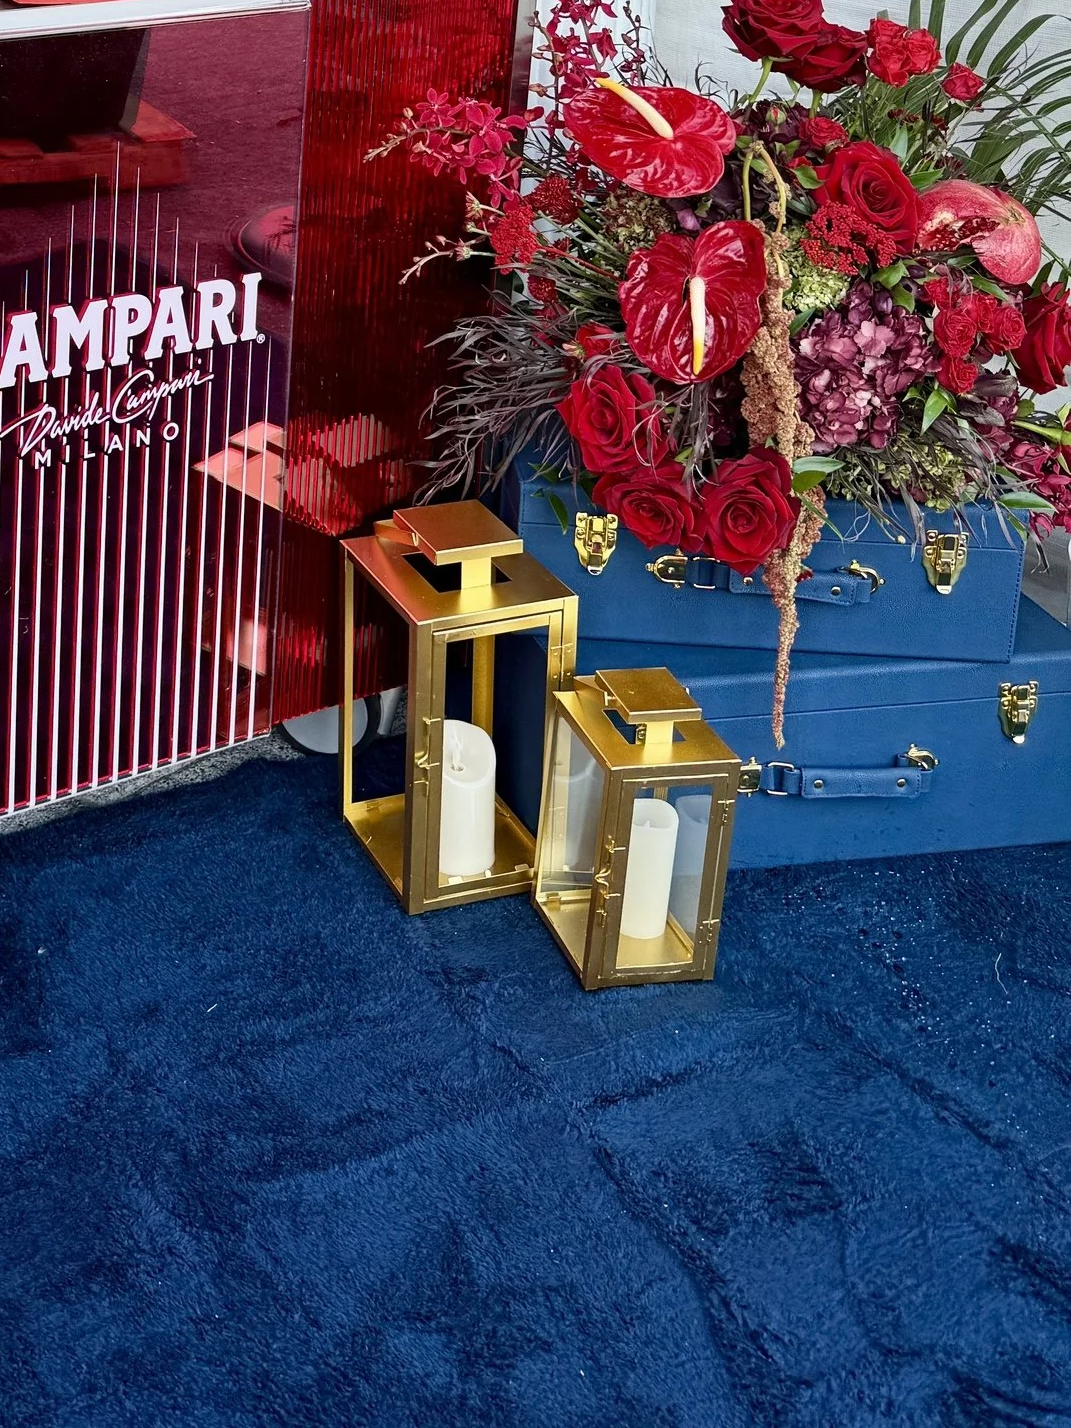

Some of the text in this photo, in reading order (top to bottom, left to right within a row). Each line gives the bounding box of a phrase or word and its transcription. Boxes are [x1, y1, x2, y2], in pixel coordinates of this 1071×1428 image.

[0, 357, 215, 457] Davide Campari
[34, 421, 180, 470] MILANO
